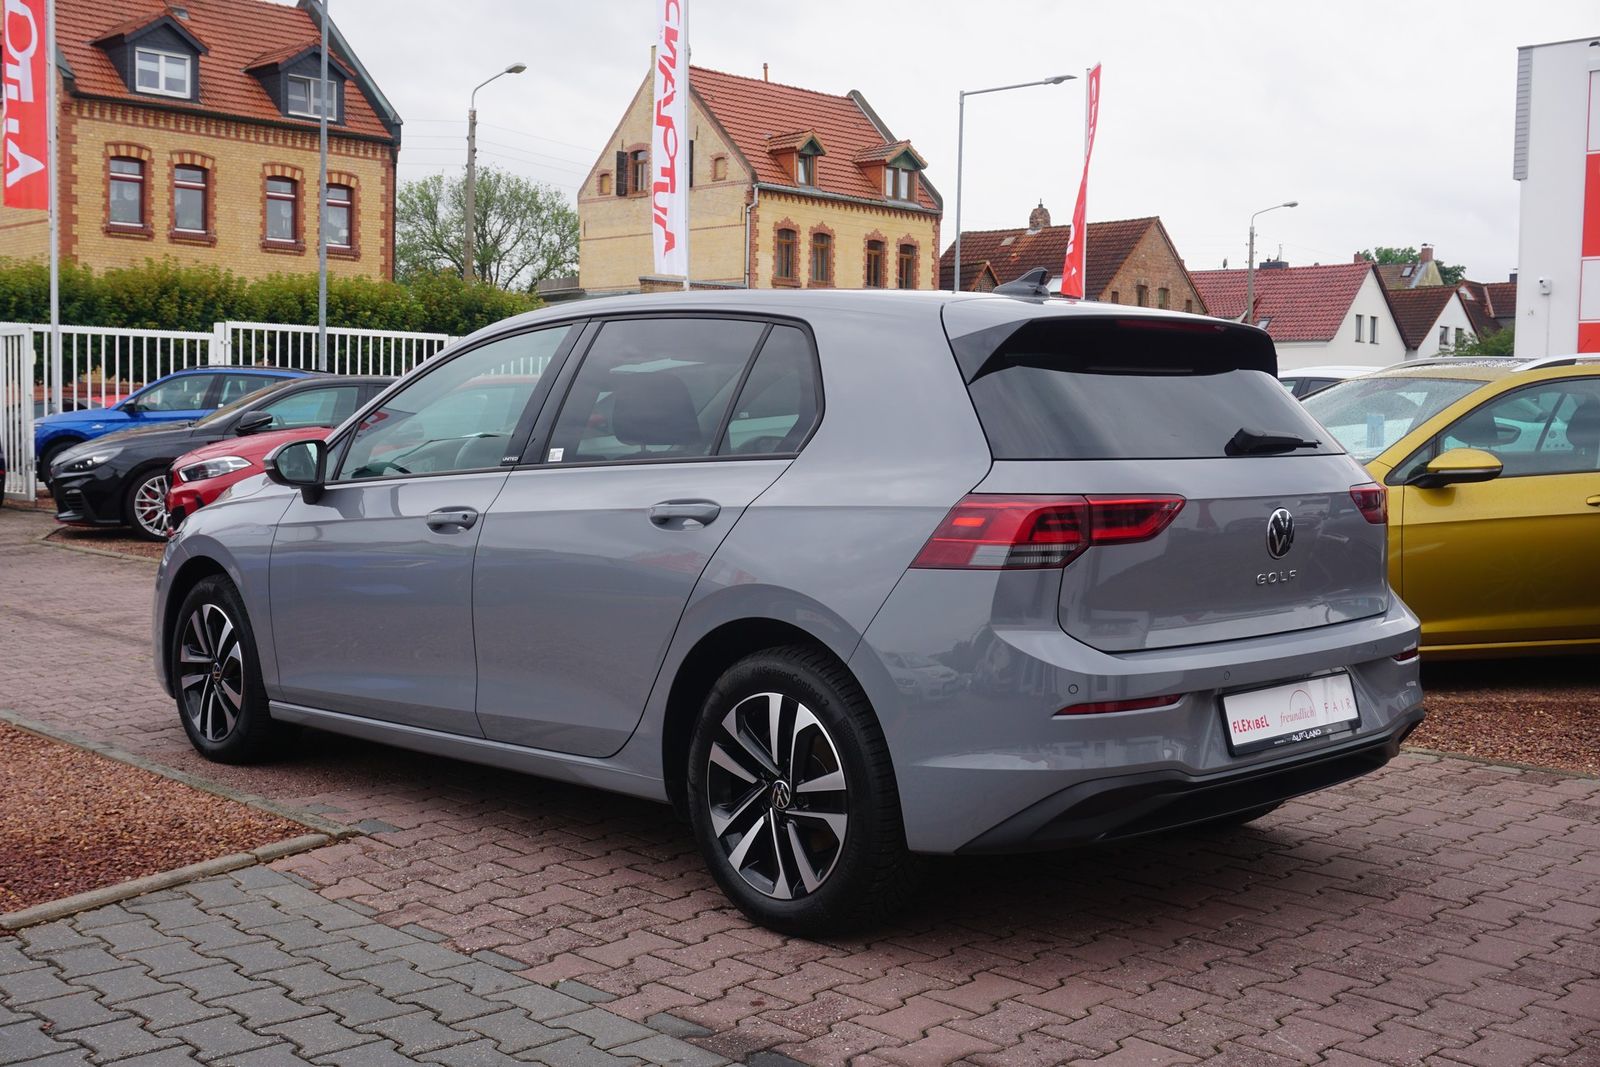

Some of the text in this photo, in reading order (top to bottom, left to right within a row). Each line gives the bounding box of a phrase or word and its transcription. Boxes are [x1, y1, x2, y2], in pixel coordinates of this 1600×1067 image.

[1256, 569, 1297, 585] GOLF
[1232, 714, 1270, 734] FLEXIBEL
[1279, 704, 1317, 727] freundlich
